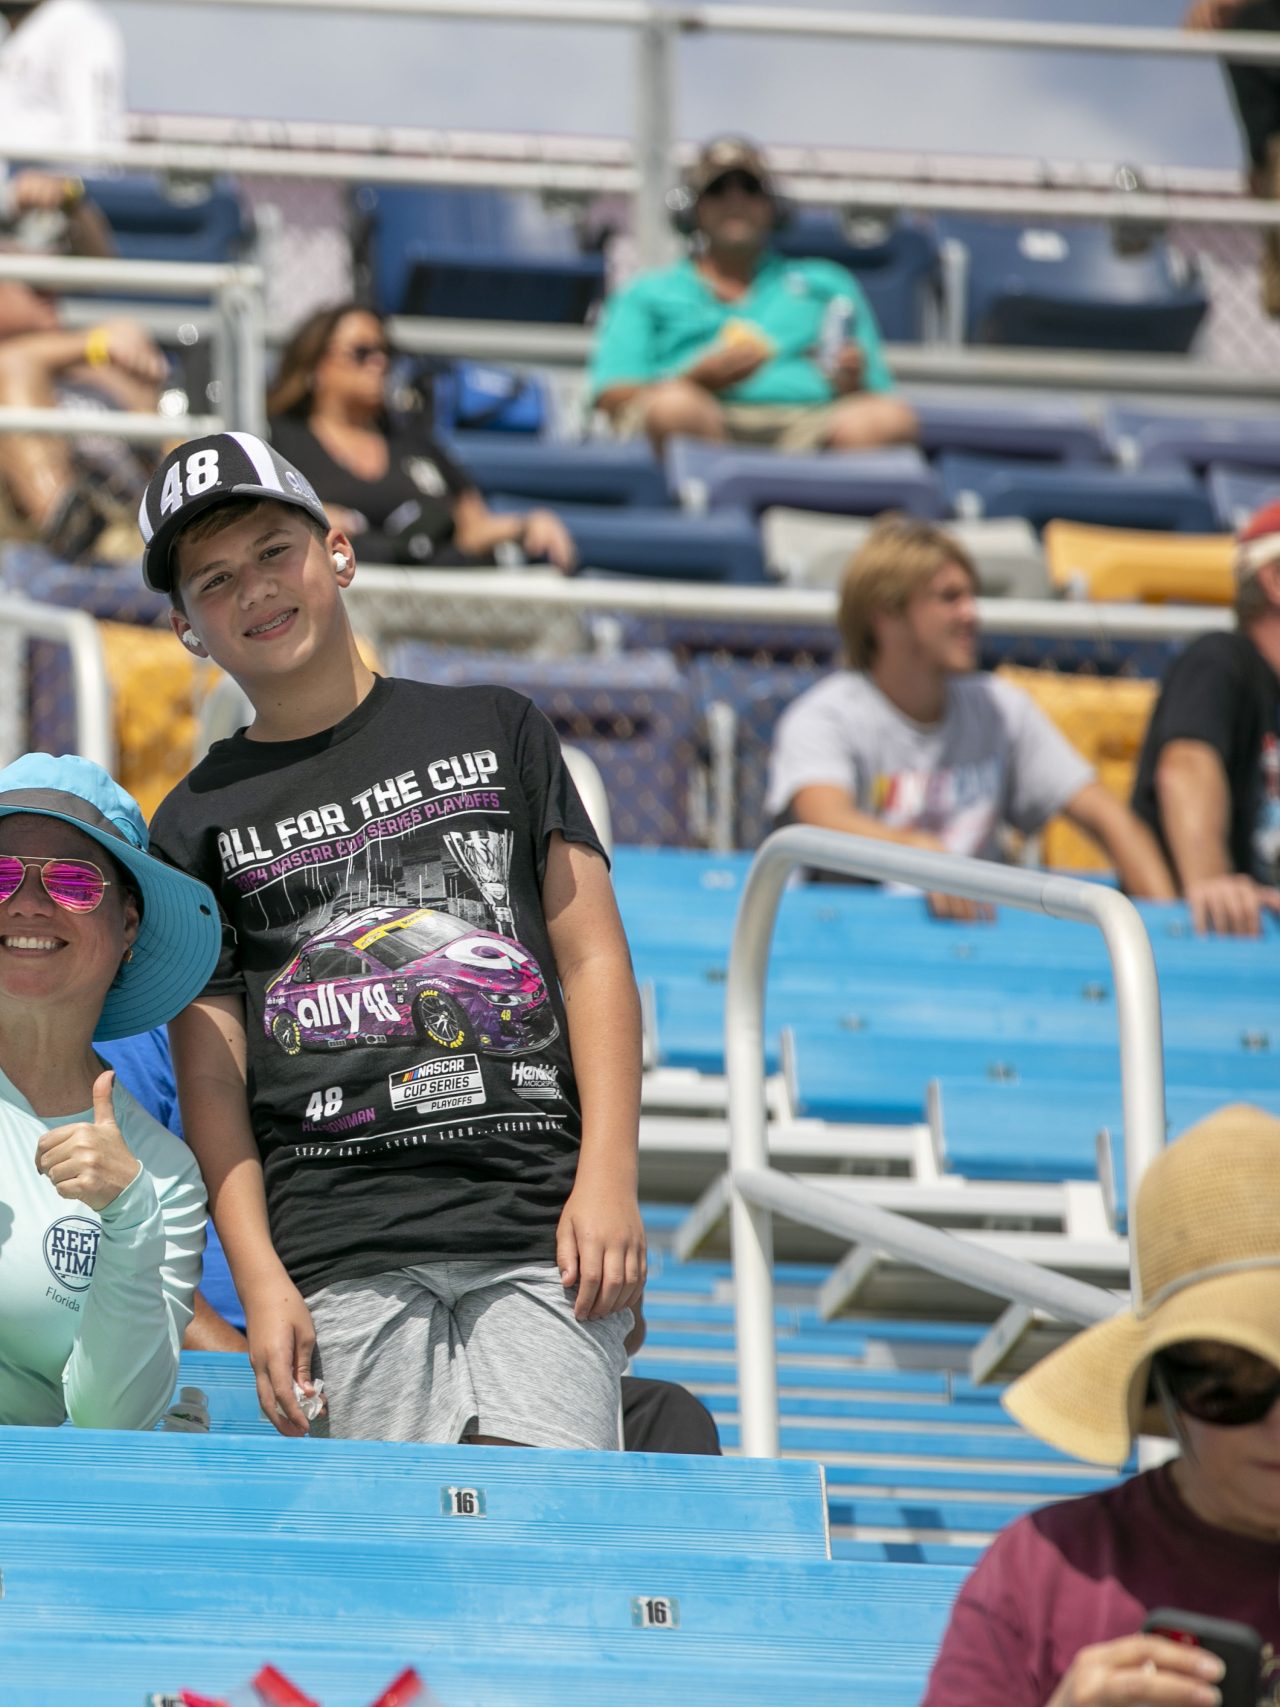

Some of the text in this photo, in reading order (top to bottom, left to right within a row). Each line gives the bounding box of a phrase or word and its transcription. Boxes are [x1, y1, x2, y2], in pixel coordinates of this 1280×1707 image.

[160, 449, 219, 517] 48
[217, 750, 499, 873] ALL FOR THE CUP
[271, 845, 332, 877] NASCAR
[336, 834, 366, 857] CUP
[367, 809, 422, 838] SERIES
[424, 792, 500, 818] PLAYOFFS
[297, 983, 402, 1033] ally 48
[418, 1059, 465, 1078] NASCAR
[404, 1076, 470, 1098] CUP SERIES
[305, 1086, 343, 1122] 48
[431, 1096, 473, 1110] PLAYOFFS
[45, 1286, 80, 1312] Florida
[454, 1491, 474, 1515] 16
[646, 1600, 667, 1624] 16
